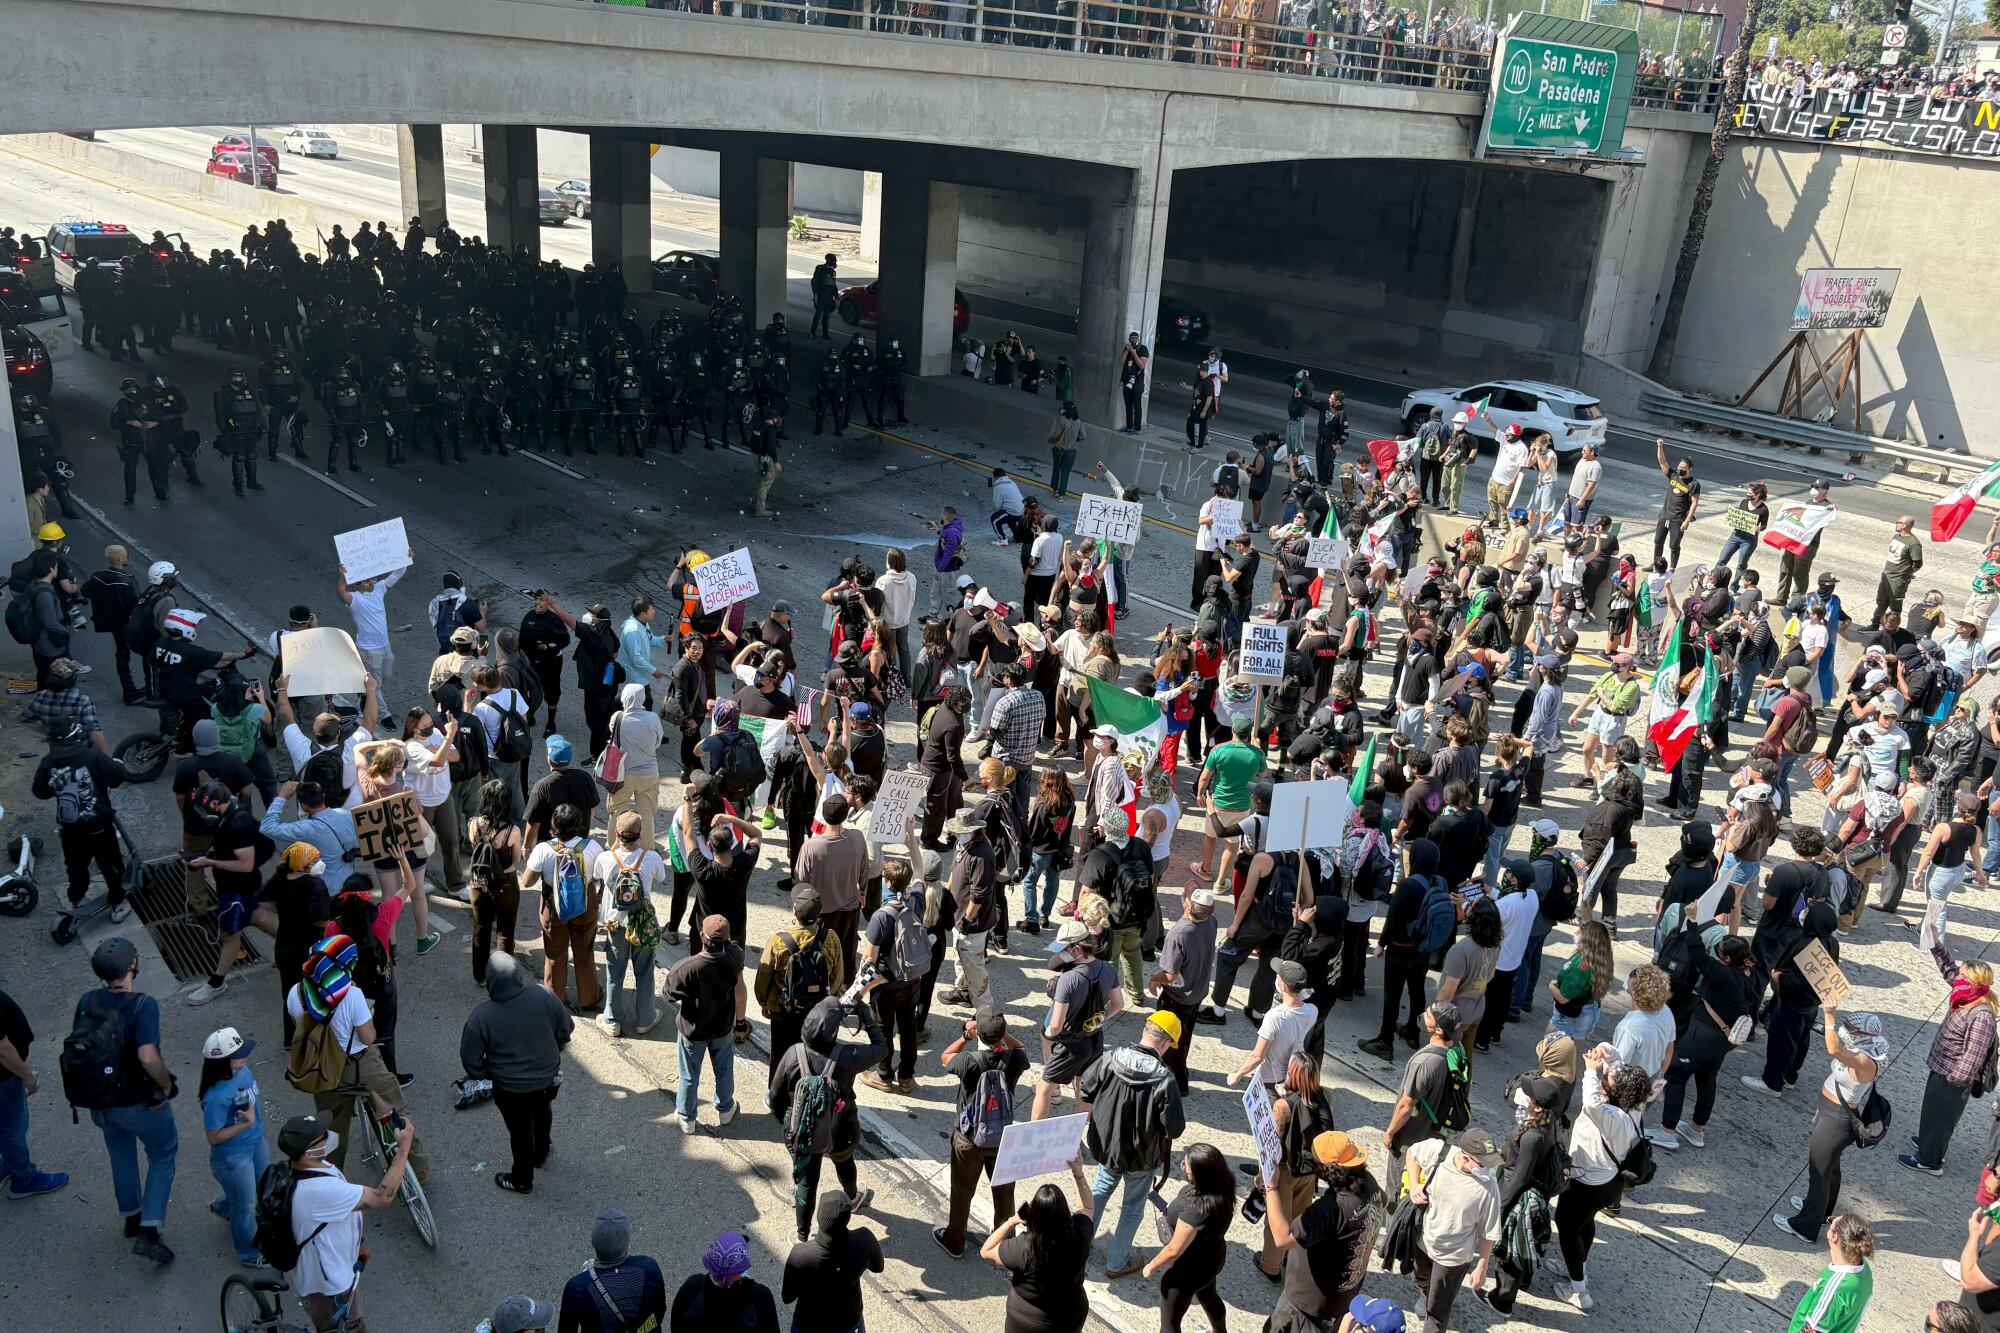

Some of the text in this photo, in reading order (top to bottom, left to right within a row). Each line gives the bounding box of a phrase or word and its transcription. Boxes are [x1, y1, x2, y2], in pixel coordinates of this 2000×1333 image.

[1541, 49, 1609, 77] San Pedro
[1510, 64, 1526, 86] 110
[1538, 79, 1601, 104] Pasadena
[1823, 88, 1915, 119] MUST
[1517, 105, 1563, 133] 1/2 MILE
[1824, 277, 1878, 288] TRAFFIC FINES
[695, 555, 738, 580] NO ONE'S
[707, 567, 747, 587] ILLEGAL
[717, 582, 729, 591] ON
[704, 581, 756, 610] STOLEN LAND
[1253, 627, 1279, 640] FULL
[1244, 639, 1284, 653] RIGHTS
[1243, 656, 1282, 668] FOR ALL
[1243, 667, 1282, 675] IMMIGRANTS!
[887, 774, 928, 789] CUFFED?
[890, 788, 911, 800] CALL
[354, 797, 415, 826] FUCK
[883, 800, 908, 813] 424
[879, 812, 903, 824] 610
[873, 822, 902, 837] 3020
[1803, 961, 1819, 975] OF
[1811, 944, 1849, 995] ICE OUT
